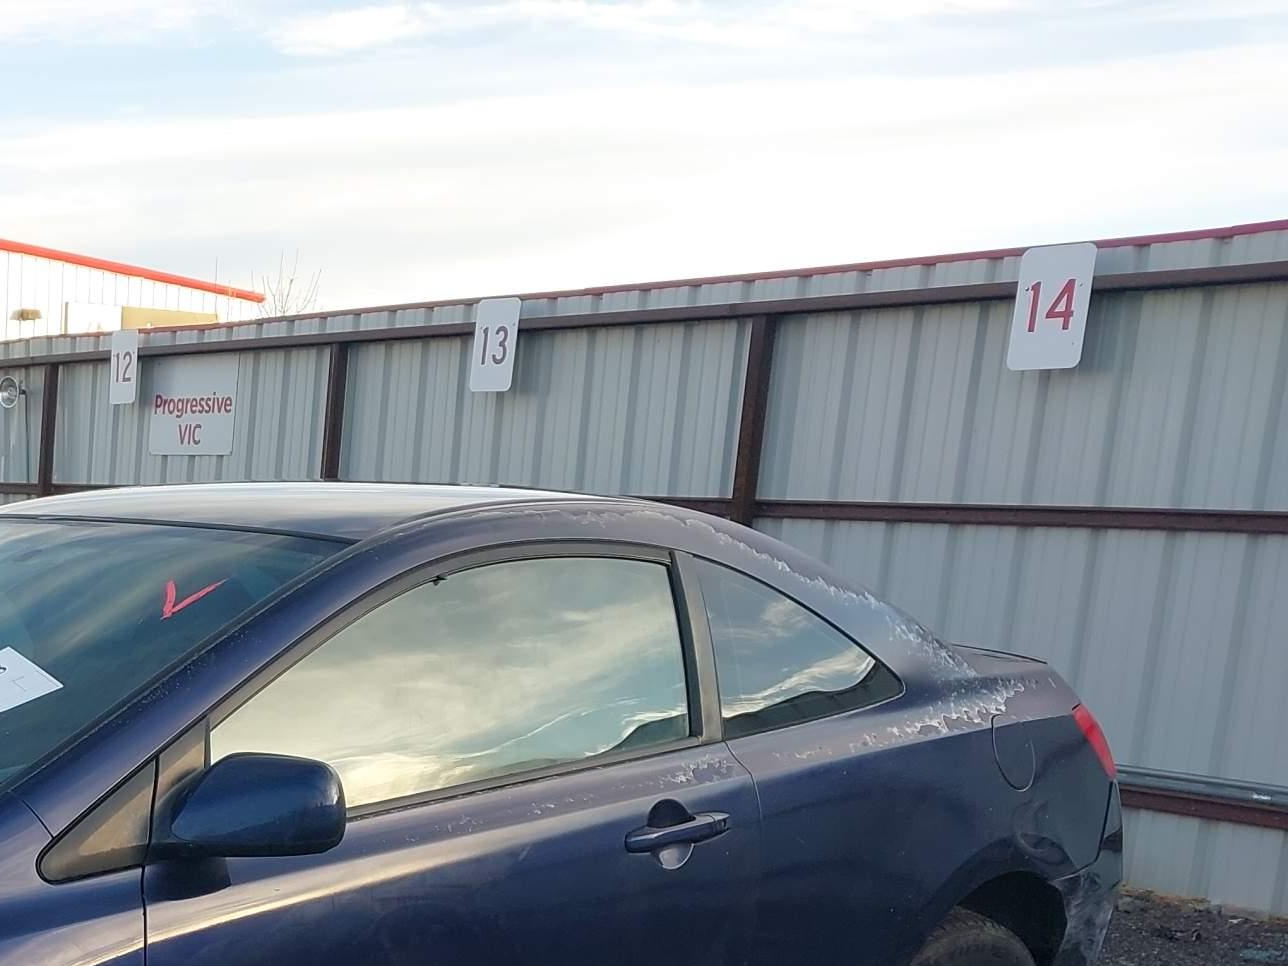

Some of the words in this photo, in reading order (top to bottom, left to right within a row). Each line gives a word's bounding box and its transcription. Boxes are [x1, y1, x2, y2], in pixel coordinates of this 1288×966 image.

[1027, 278, 1076, 332] 14
[480, 325, 509, 365] 13
[115, 350, 133, 383] 12
[154, 392, 233, 418] Progressive
[178, 424, 202, 446] VIC
